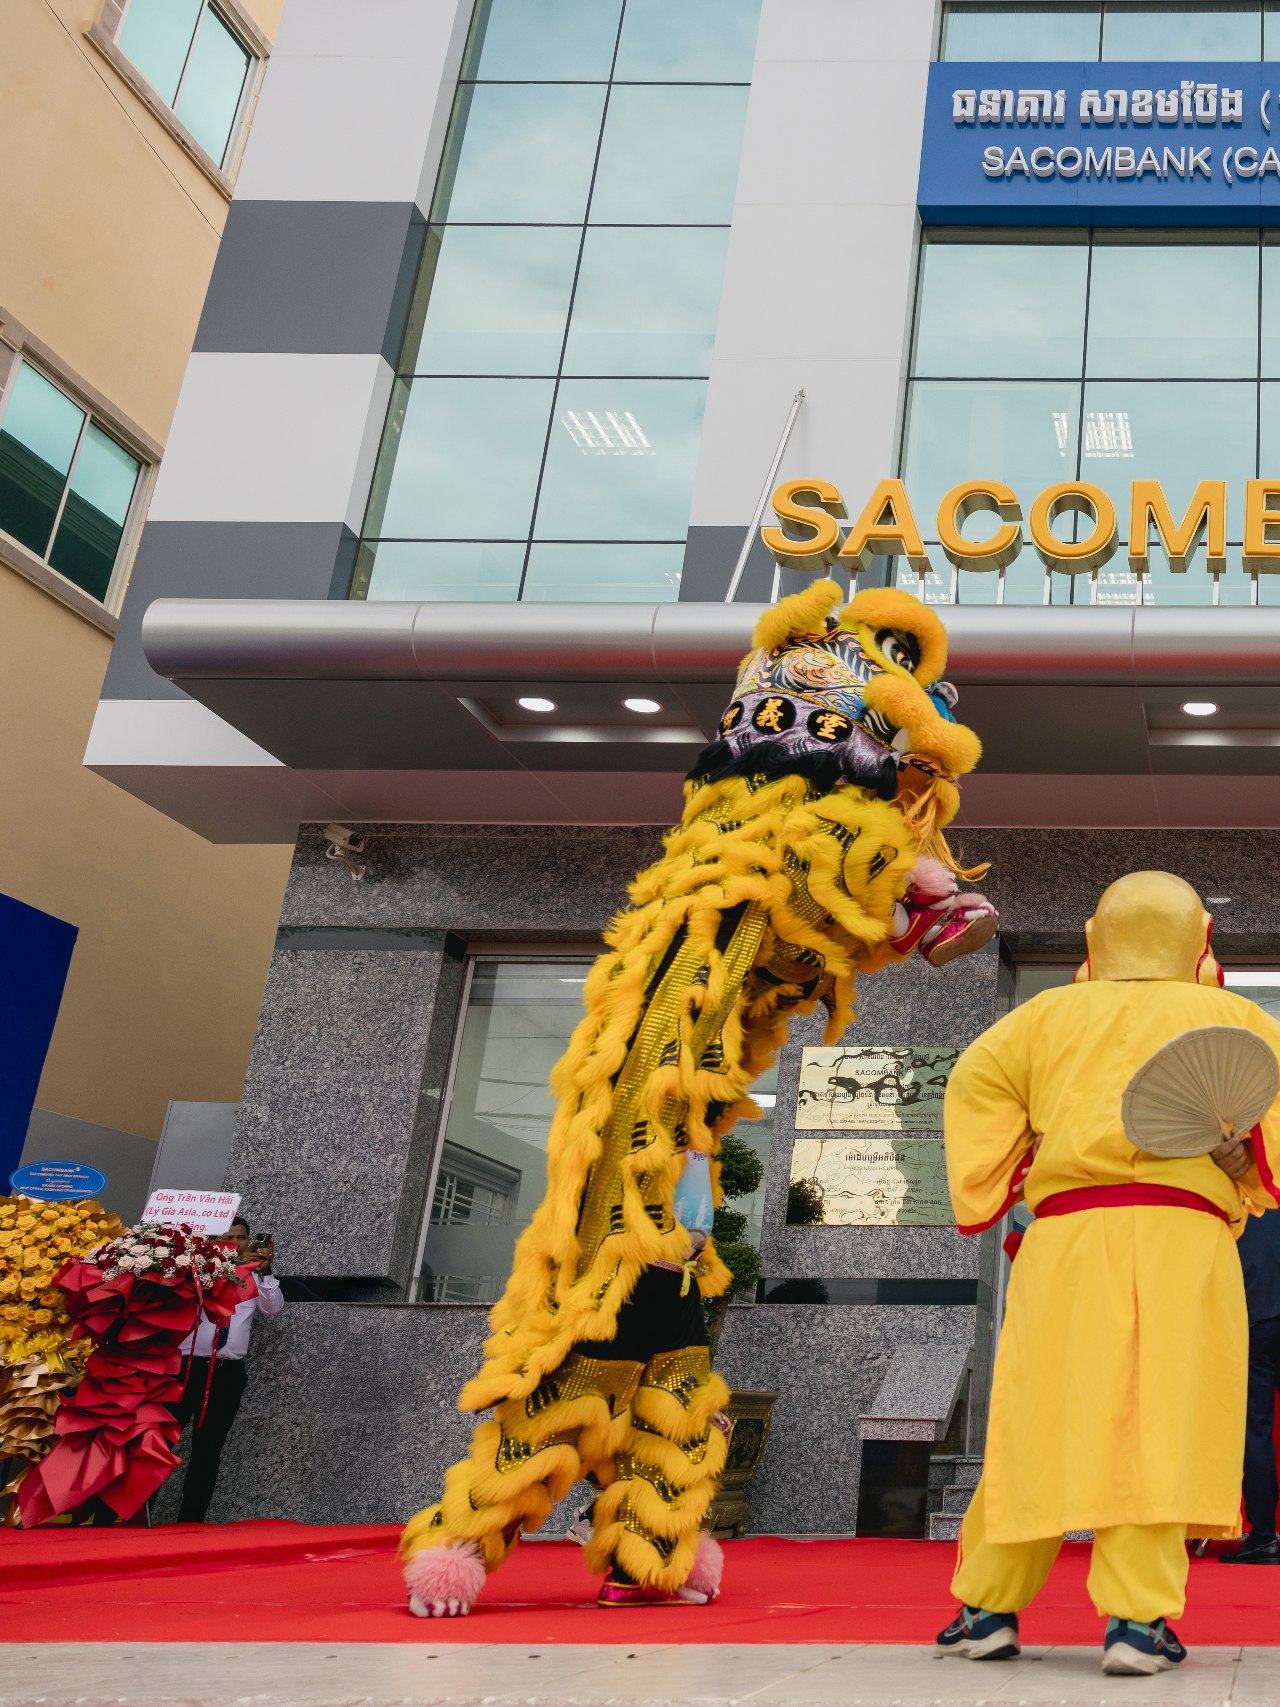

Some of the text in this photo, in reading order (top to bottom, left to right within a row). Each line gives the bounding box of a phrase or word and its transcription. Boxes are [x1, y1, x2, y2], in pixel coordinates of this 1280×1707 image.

[952, 89, 1066, 124] ធនាគារ
[982, 146, 1212, 178] SACOMBANK
[161, 1207, 176, 1216] Gia
